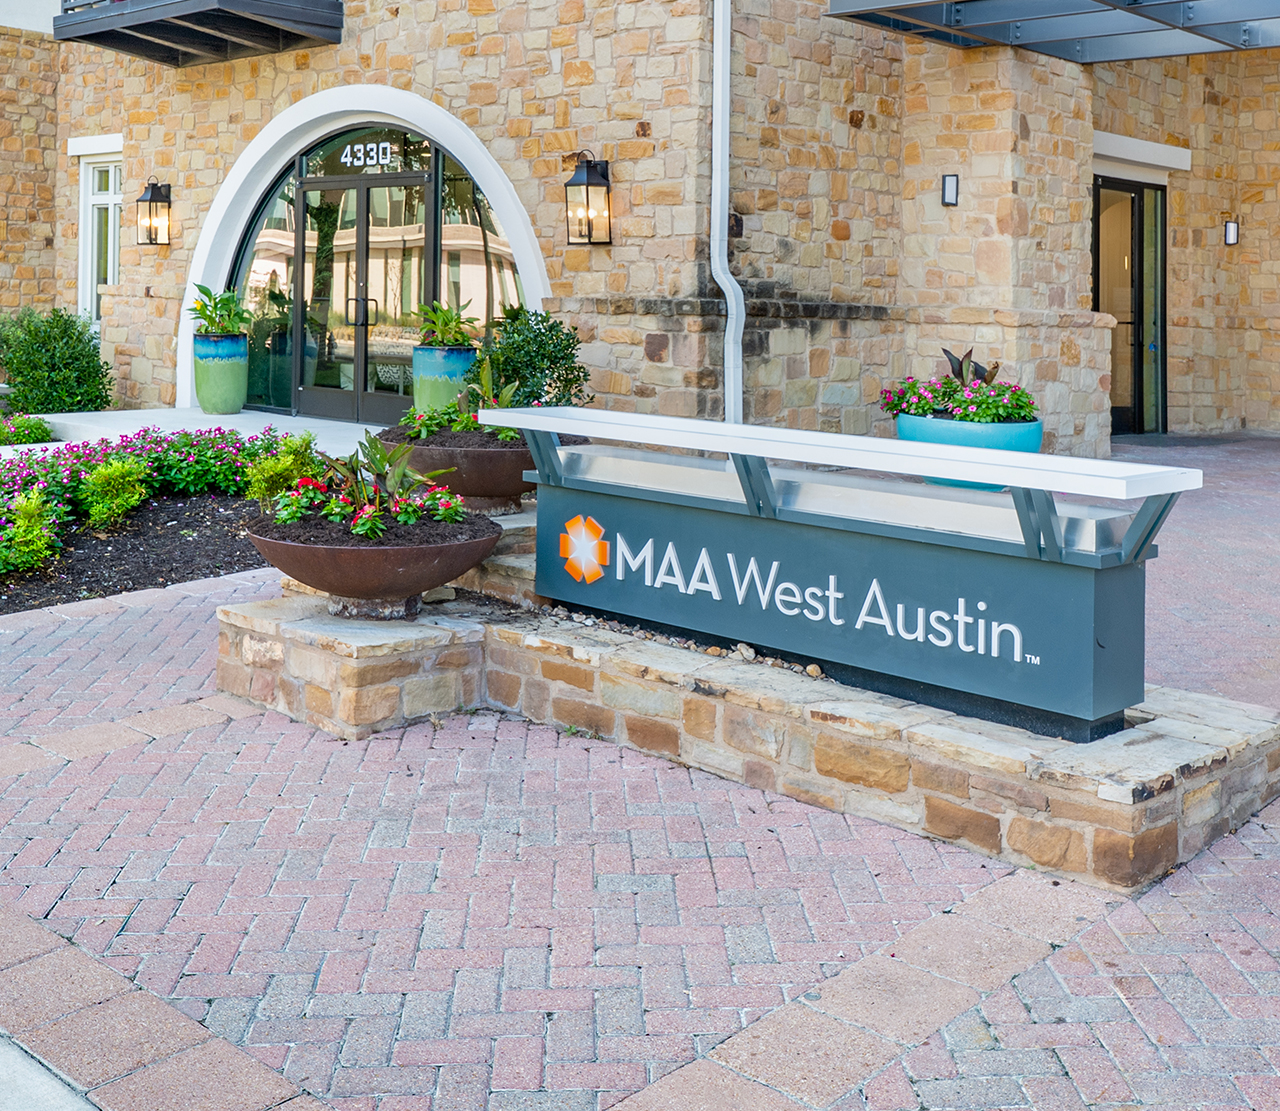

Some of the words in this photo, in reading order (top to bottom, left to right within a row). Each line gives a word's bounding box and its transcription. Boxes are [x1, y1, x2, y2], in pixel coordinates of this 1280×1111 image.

[340, 142, 391, 167] 4330
[616, 532, 722, 601] MAA
[726, 552, 845, 626] West
[855, 578, 1024, 663] Austin
